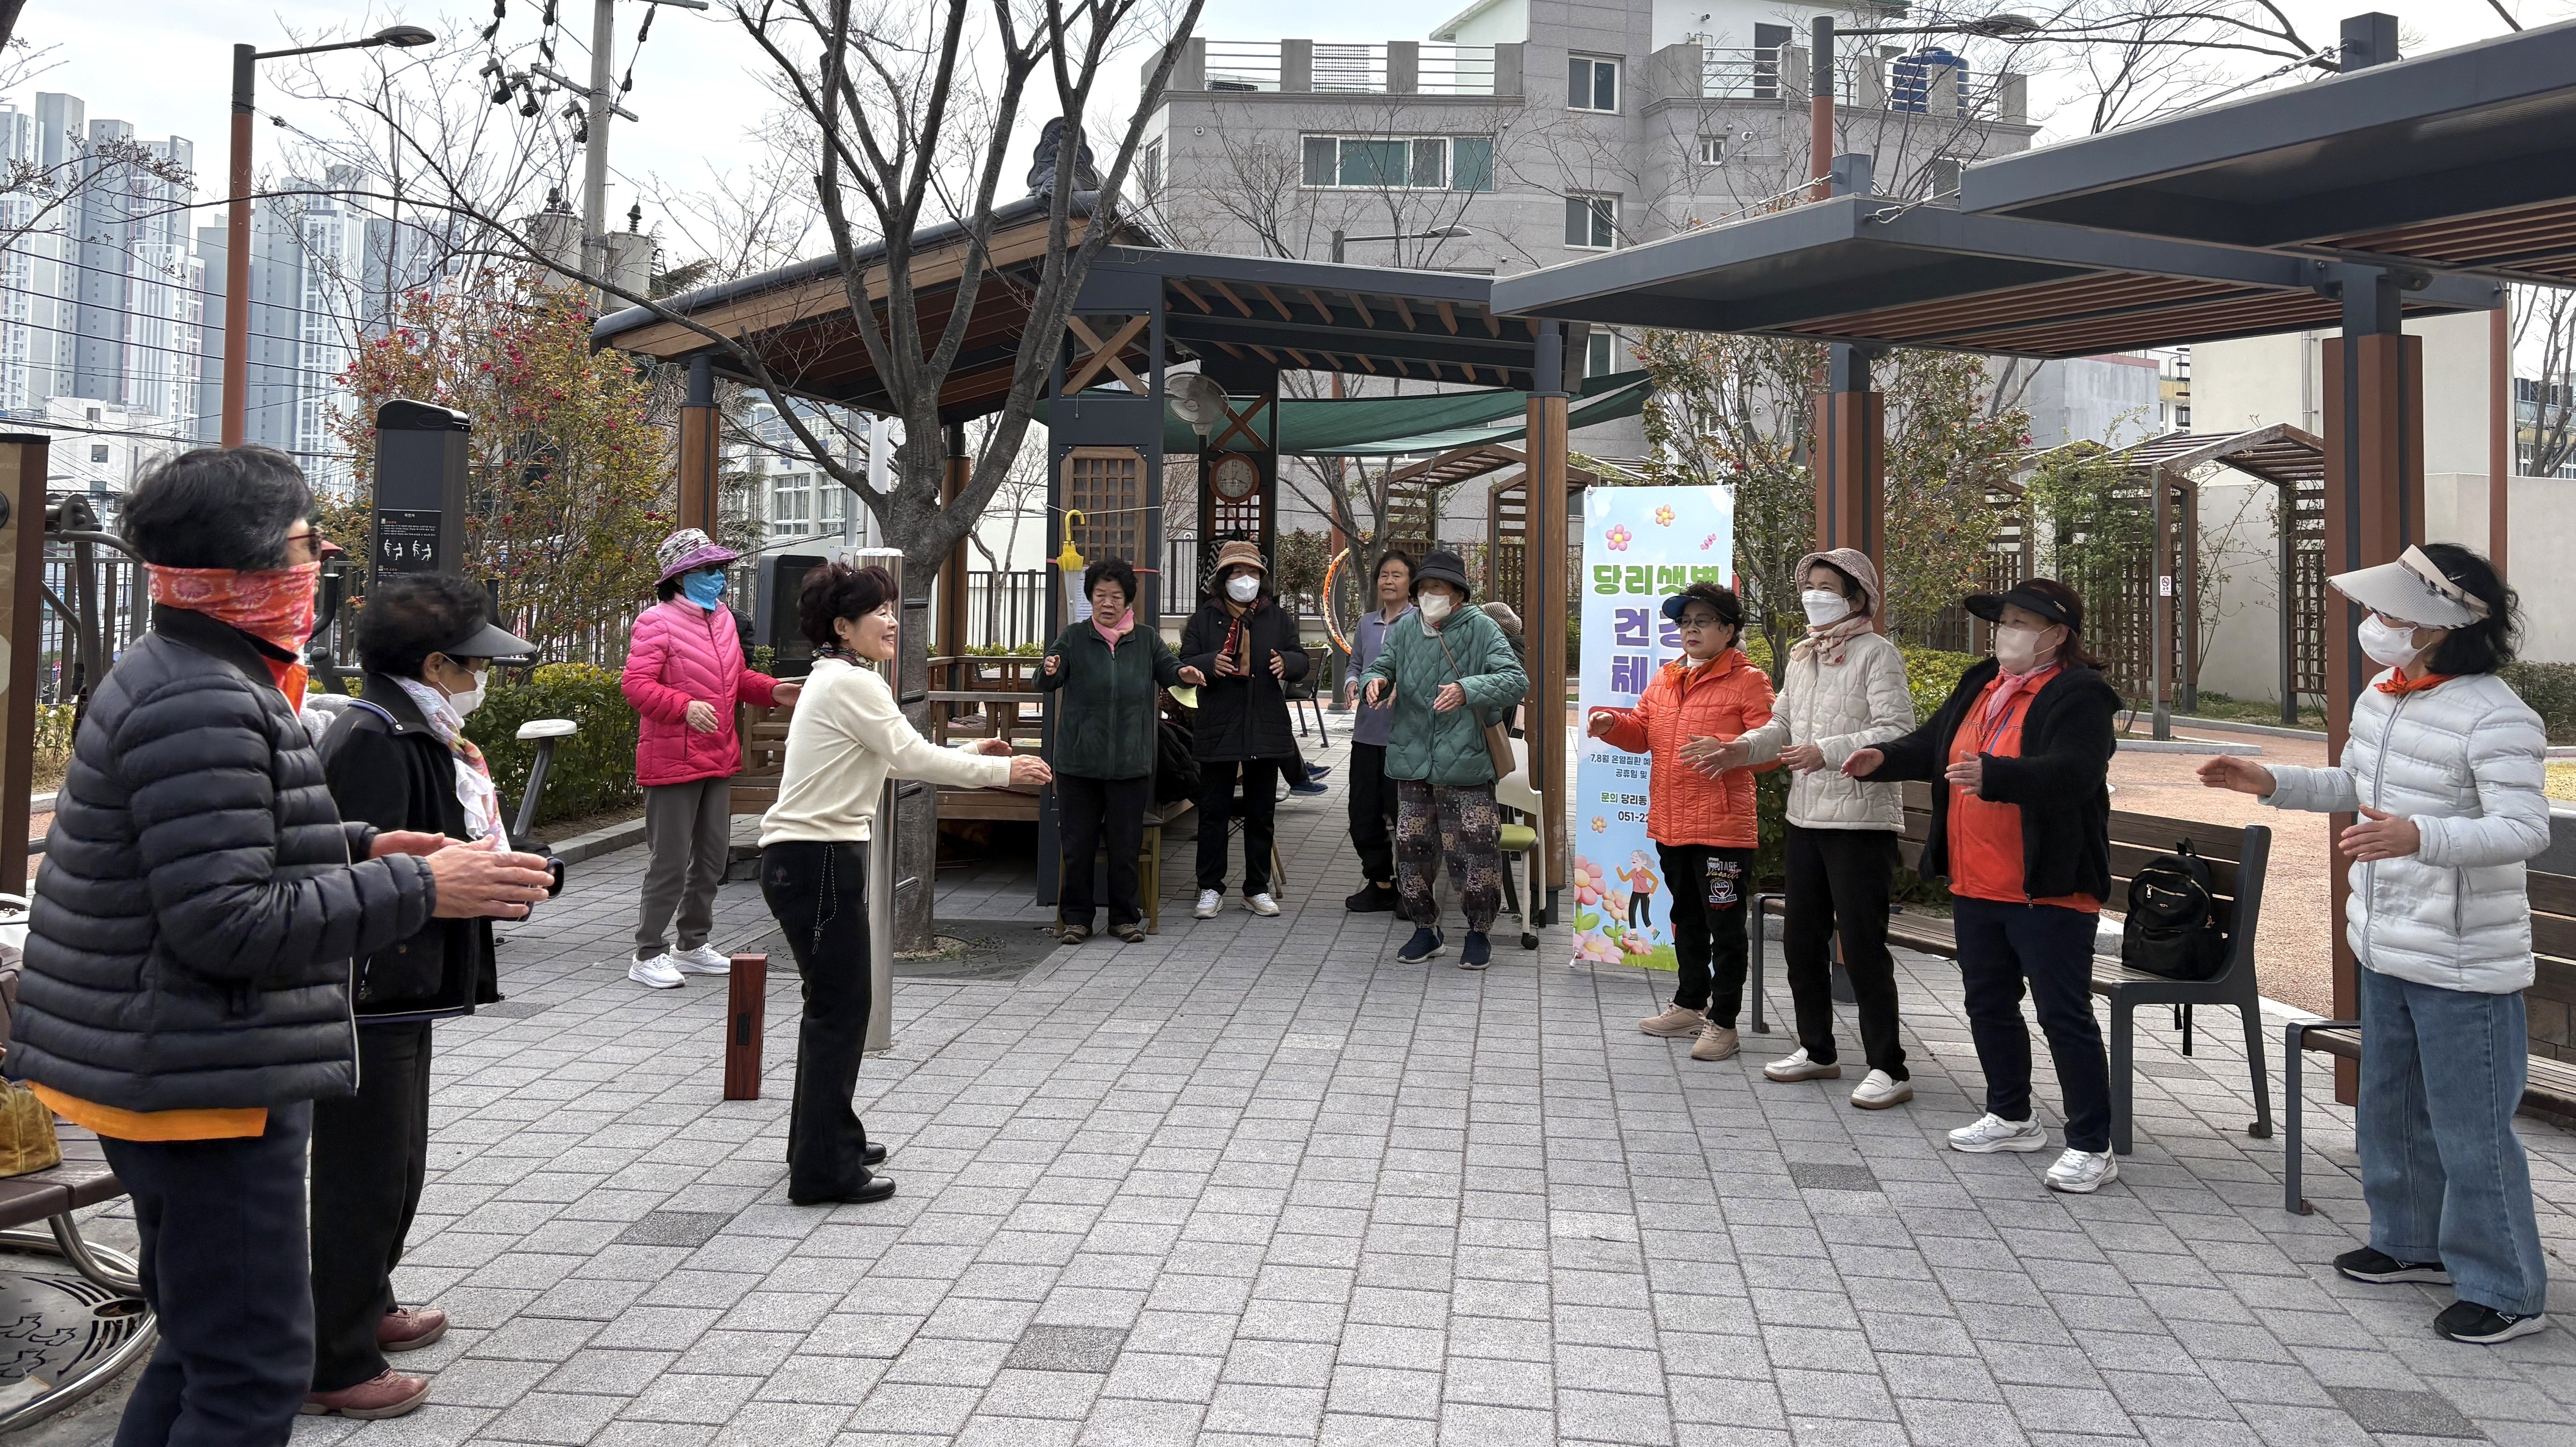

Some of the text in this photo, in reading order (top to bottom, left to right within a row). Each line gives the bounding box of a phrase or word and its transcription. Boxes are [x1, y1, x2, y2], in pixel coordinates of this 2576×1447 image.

[1590, 754, 1609, 763] 7,8월
[1616, 769, 1647, 779] 공휴일 및
[1601, 792, 1647, 805] 문의 당리동
